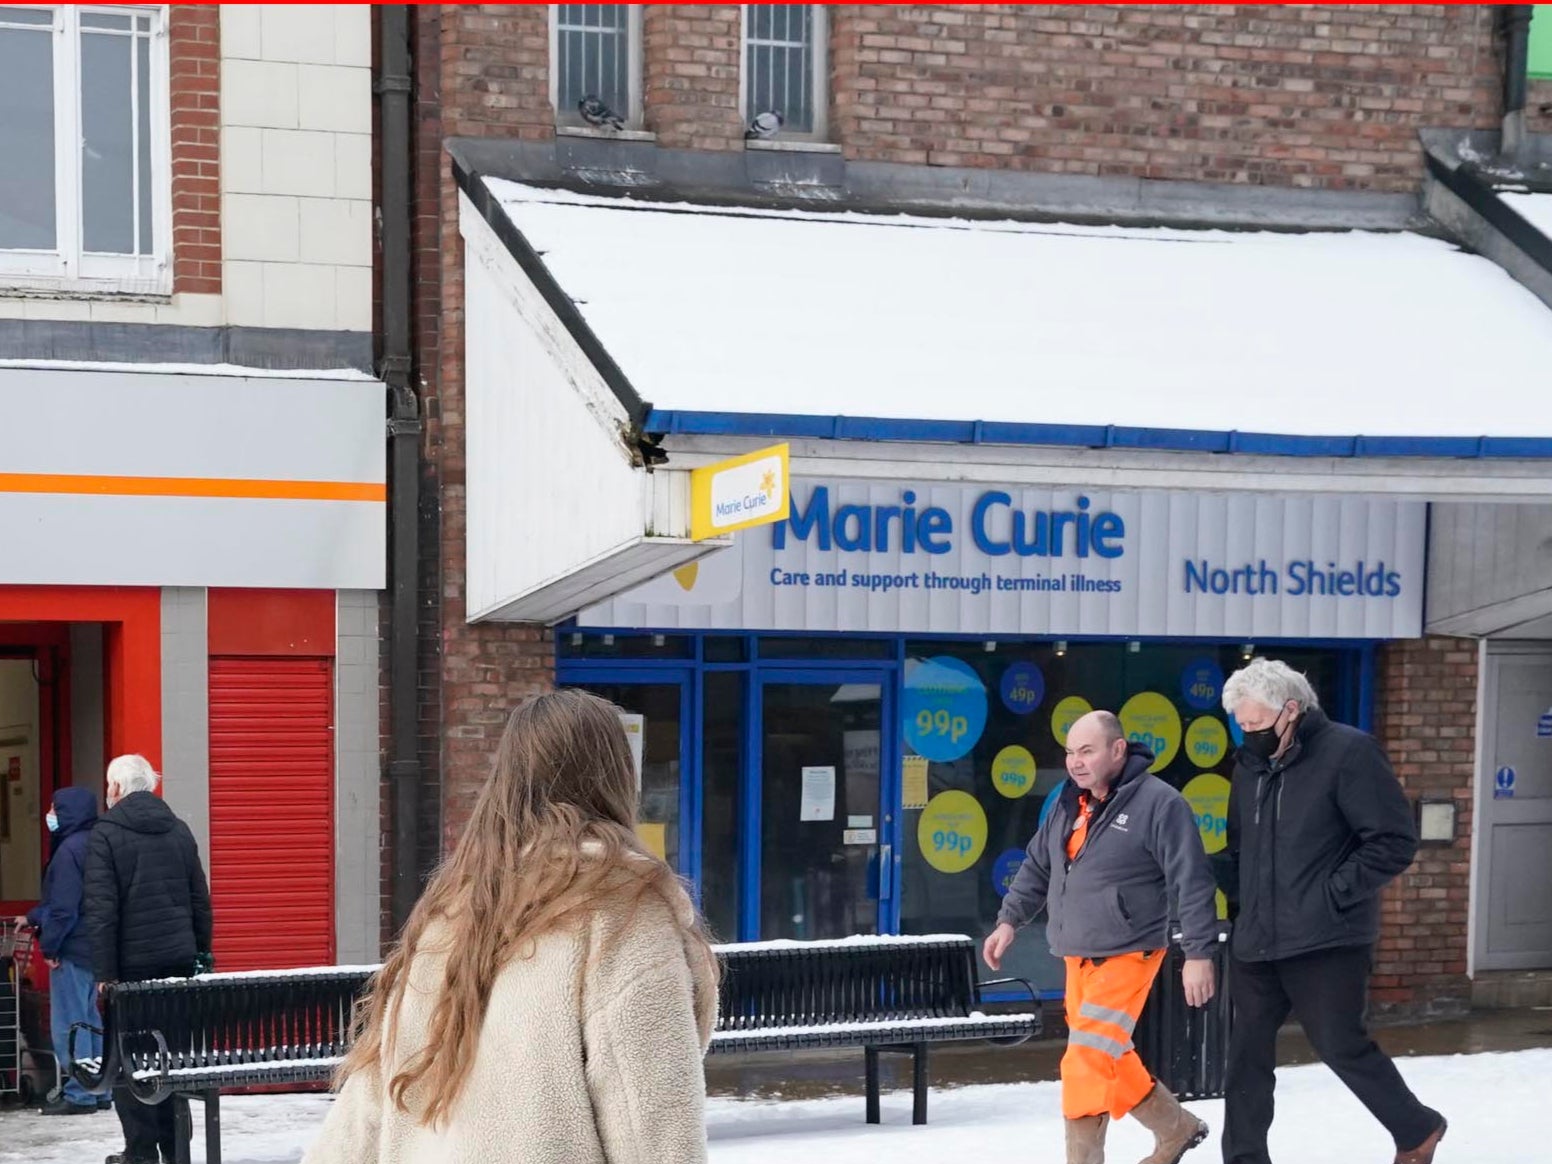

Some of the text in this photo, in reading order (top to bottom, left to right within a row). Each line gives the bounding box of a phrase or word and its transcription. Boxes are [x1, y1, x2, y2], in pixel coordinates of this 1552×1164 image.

[716, 493, 766, 517] Marie Curie
[773, 486, 1125, 558] Marie Curie
[770, 568, 1122, 594] Care and support through terminal illness
[1184, 559, 1401, 597] North Shields
[916, 710, 968, 743] 99p
[932, 830, 973, 856] 99p
